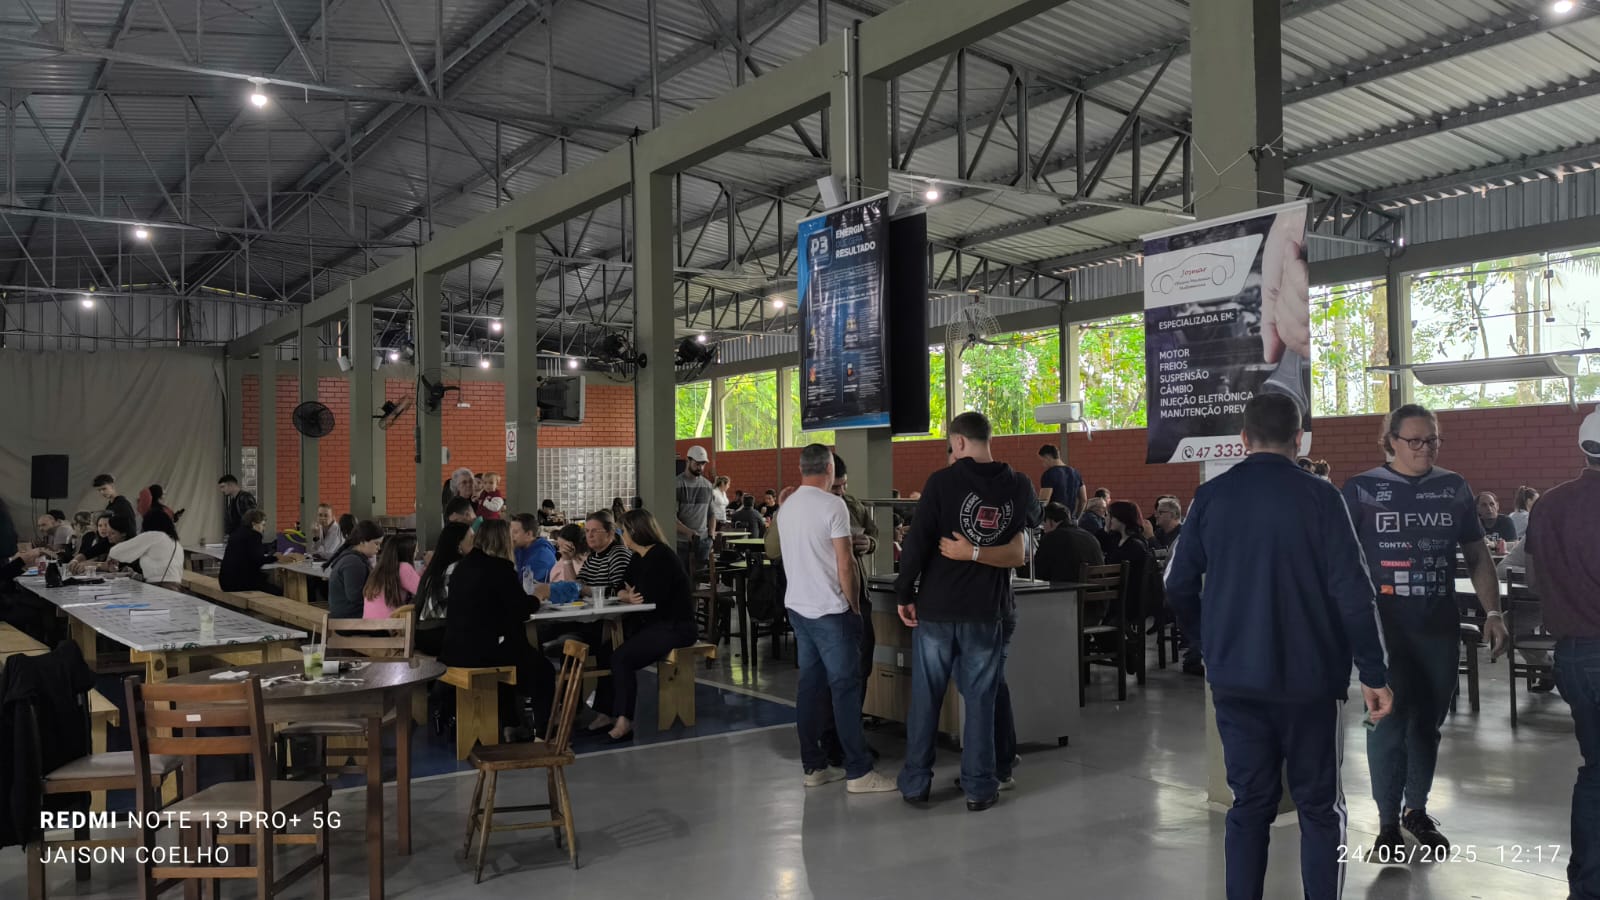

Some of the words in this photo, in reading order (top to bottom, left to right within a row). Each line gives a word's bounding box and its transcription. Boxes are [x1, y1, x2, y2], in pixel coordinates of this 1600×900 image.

[835, 224, 865, 239] ENERGIA
[811, 235, 829, 256] P3
[835, 241, 876, 259] RESULTADO
[1159, 314, 1219, 330] ESPECIALIZADA
[1220, 311, 1234, 321] EM:
[1160, 348, 1190, 360] MOTOR
[1160, 360, 1188, 372] FREIOS
[1160, 369, 1209, 384] SUSPENSÃO
[1160, 384, 1193, 395] CÂMBIO
[1160, 394, 1196, 407] INJEÇÃO
[1198, 390, 1254, 404] ELETRÔNICA
[1160, 404, 1221, 419] MANUTENÇÃO
[1195, 447, 1211, 459] 47
[1376, 490, 1393, 502] 25
